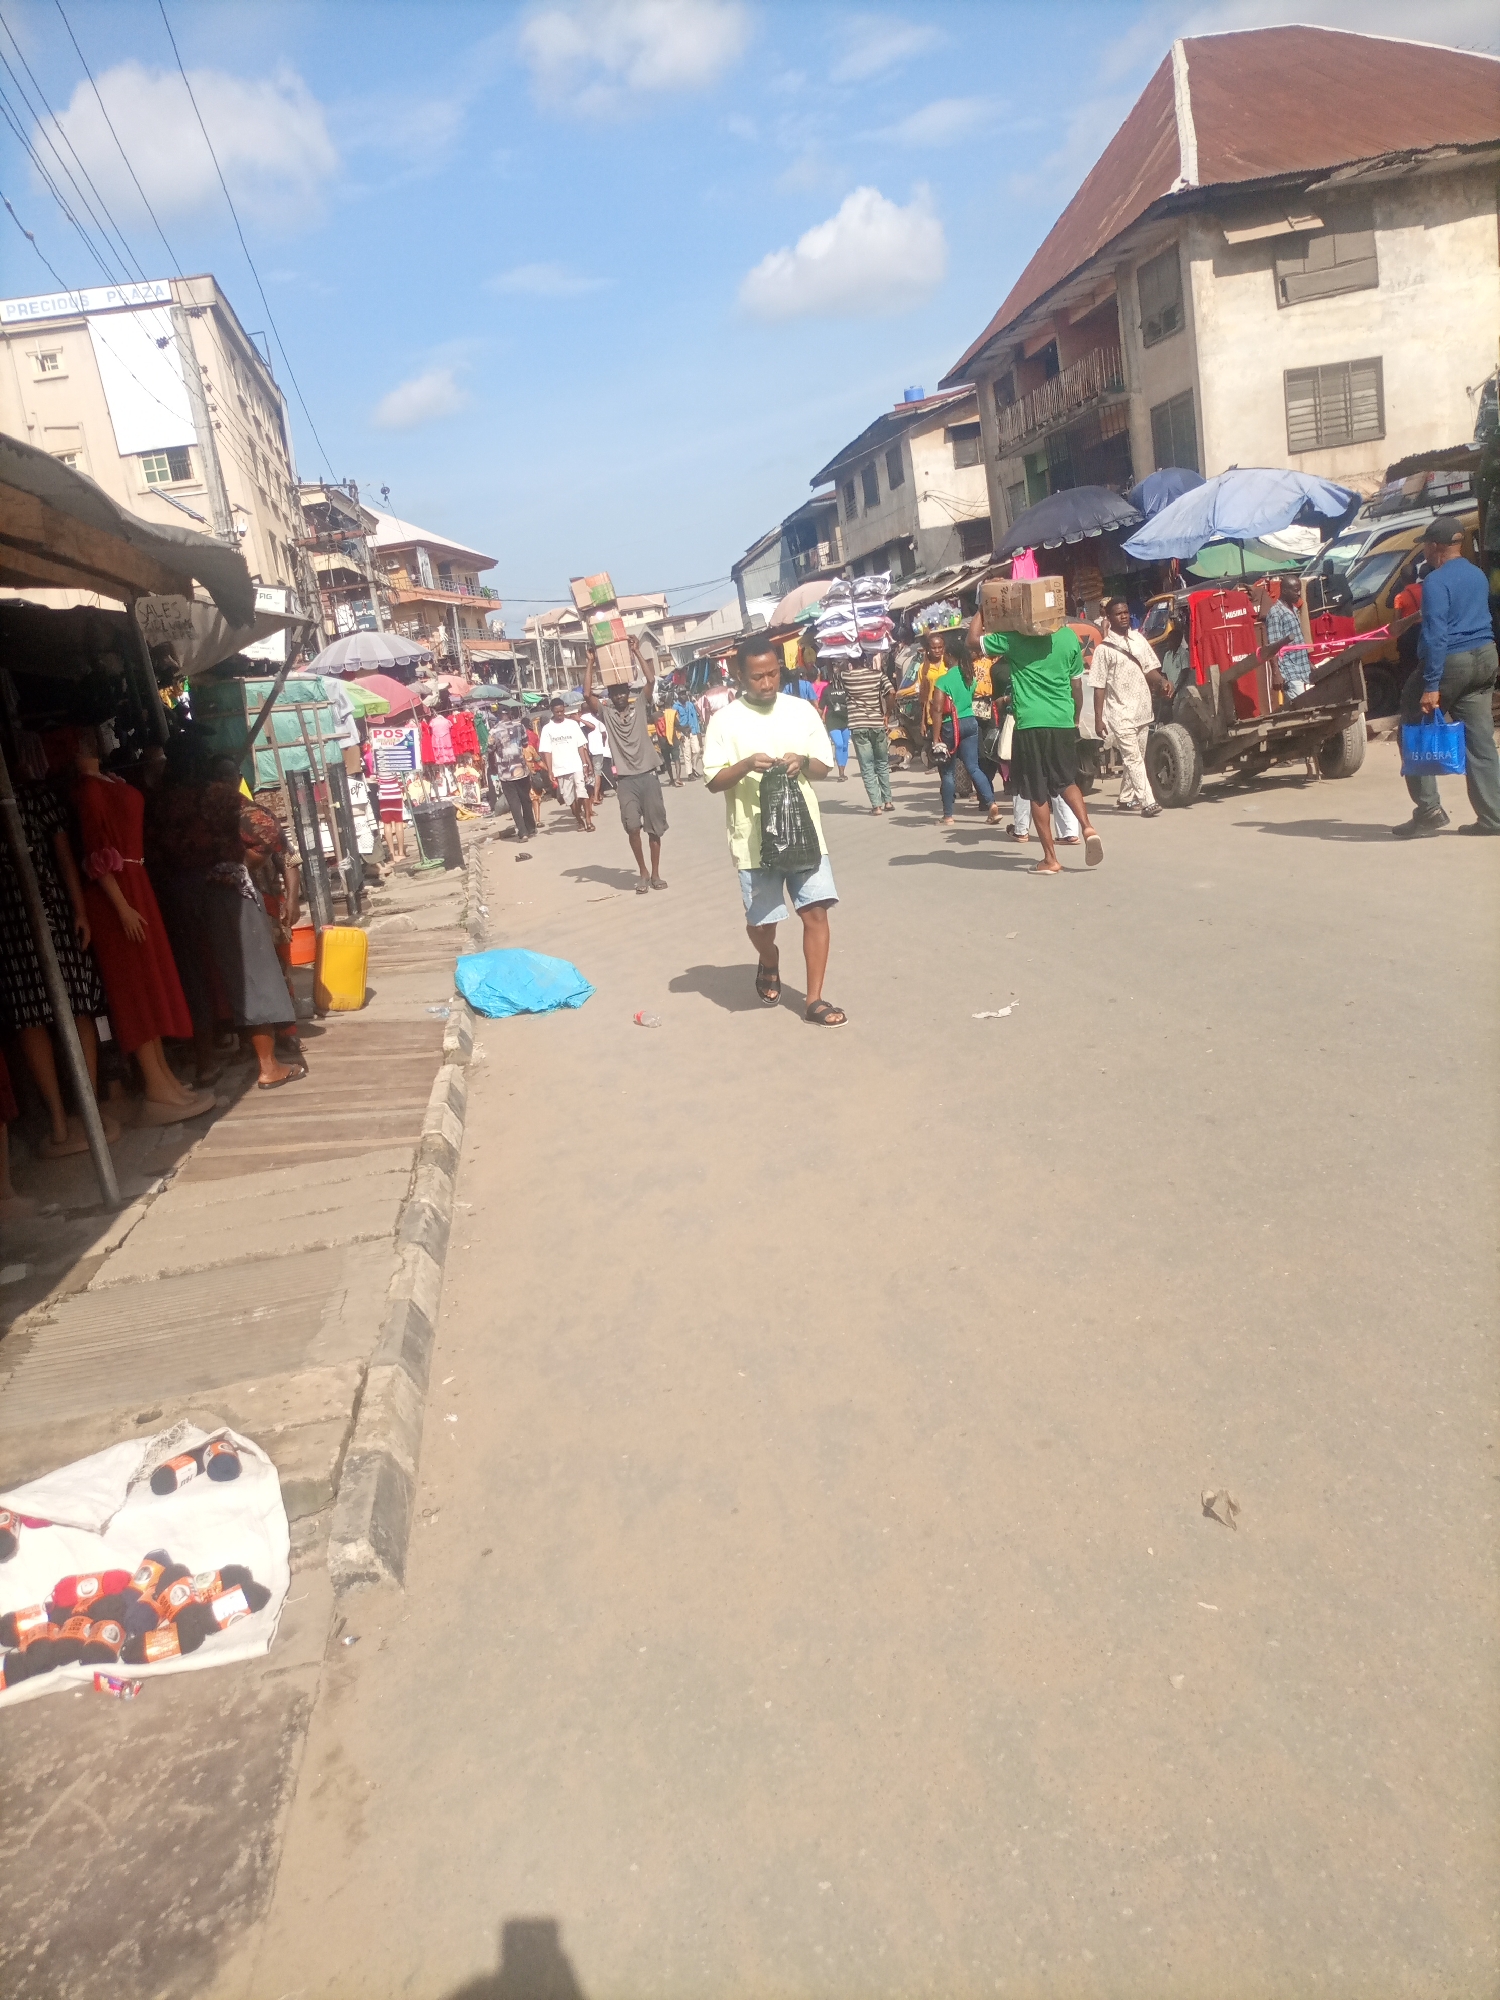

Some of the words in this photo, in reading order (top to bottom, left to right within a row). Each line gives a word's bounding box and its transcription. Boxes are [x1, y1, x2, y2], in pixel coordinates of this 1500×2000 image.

[6, 295, 90, 317] PRECIOUS
[106, 284, 165, 303] PLAZA
[138, 601, 181, 624] SALES
[373, 729, 404, 739] POS
